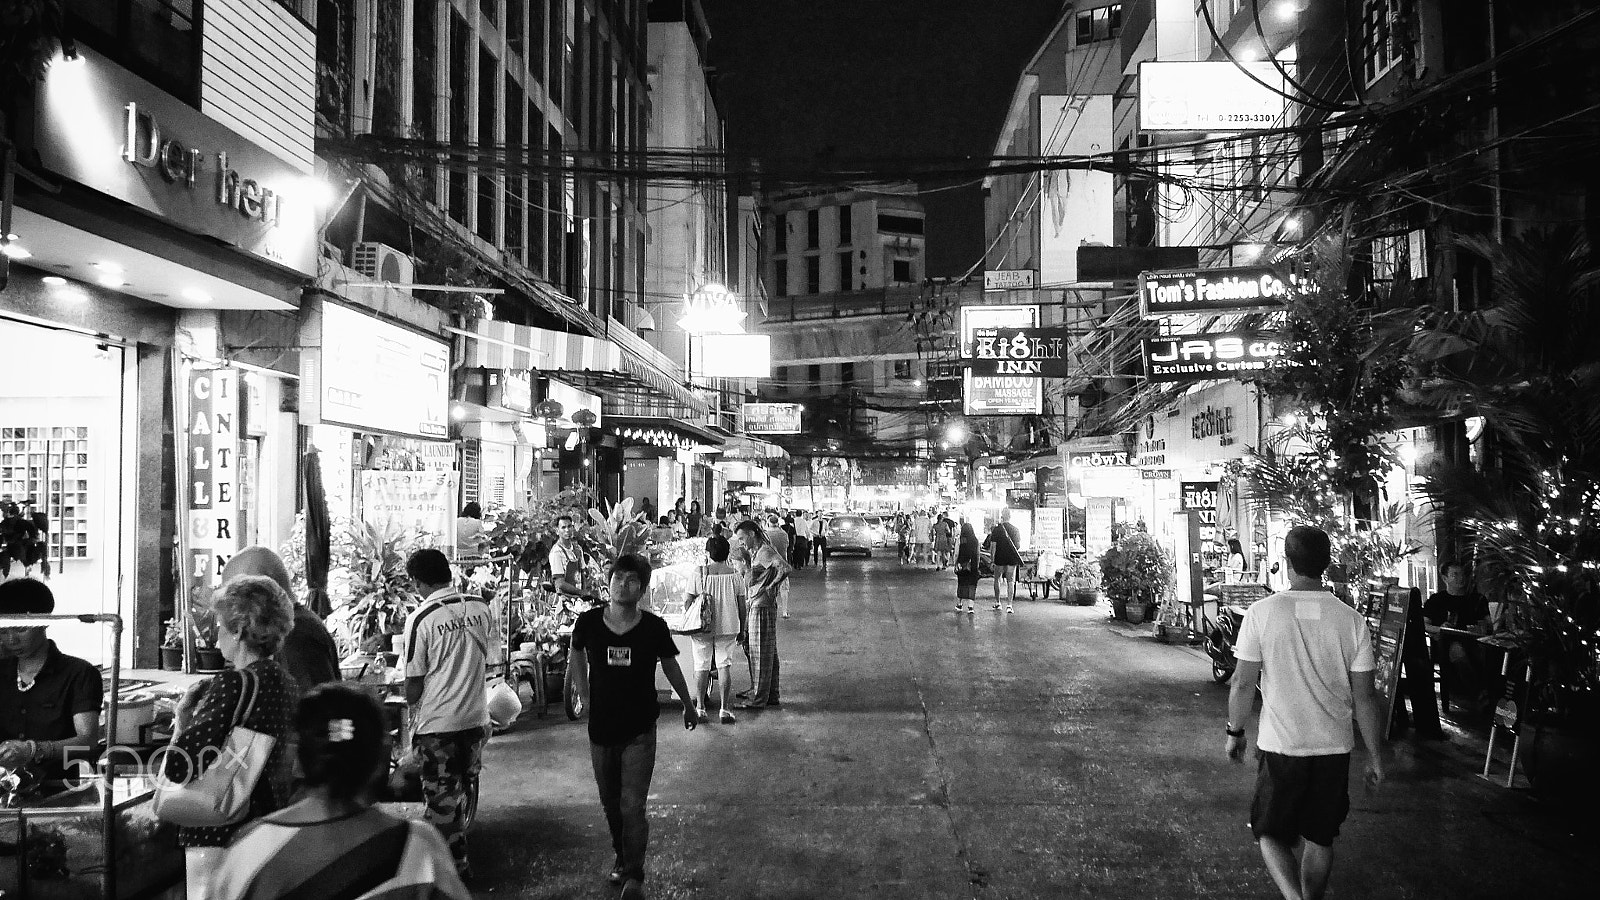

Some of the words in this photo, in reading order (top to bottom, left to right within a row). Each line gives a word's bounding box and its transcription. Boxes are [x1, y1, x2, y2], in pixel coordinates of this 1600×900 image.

[121, 101, 205, 189] Der
[994, 271, 1020, 281] JEAB
[1147, 279, 1195, 302] Tom's
[1196, 276, 1259, 300] Fashion
[1151, 337, 1244, 362] JAS
[996, 360, 1042, 374] INN
[1152, 362, 1213, 374] Exclusive
[994, 388, 1033, 398] MASSAGE
[194, 376, 210, 506] CALL
[424, 444, 454, 458] LAUNDRY
[1072, 453, 1128, 467] CROWN
[1143, 471, 1170, 479] CROWN
